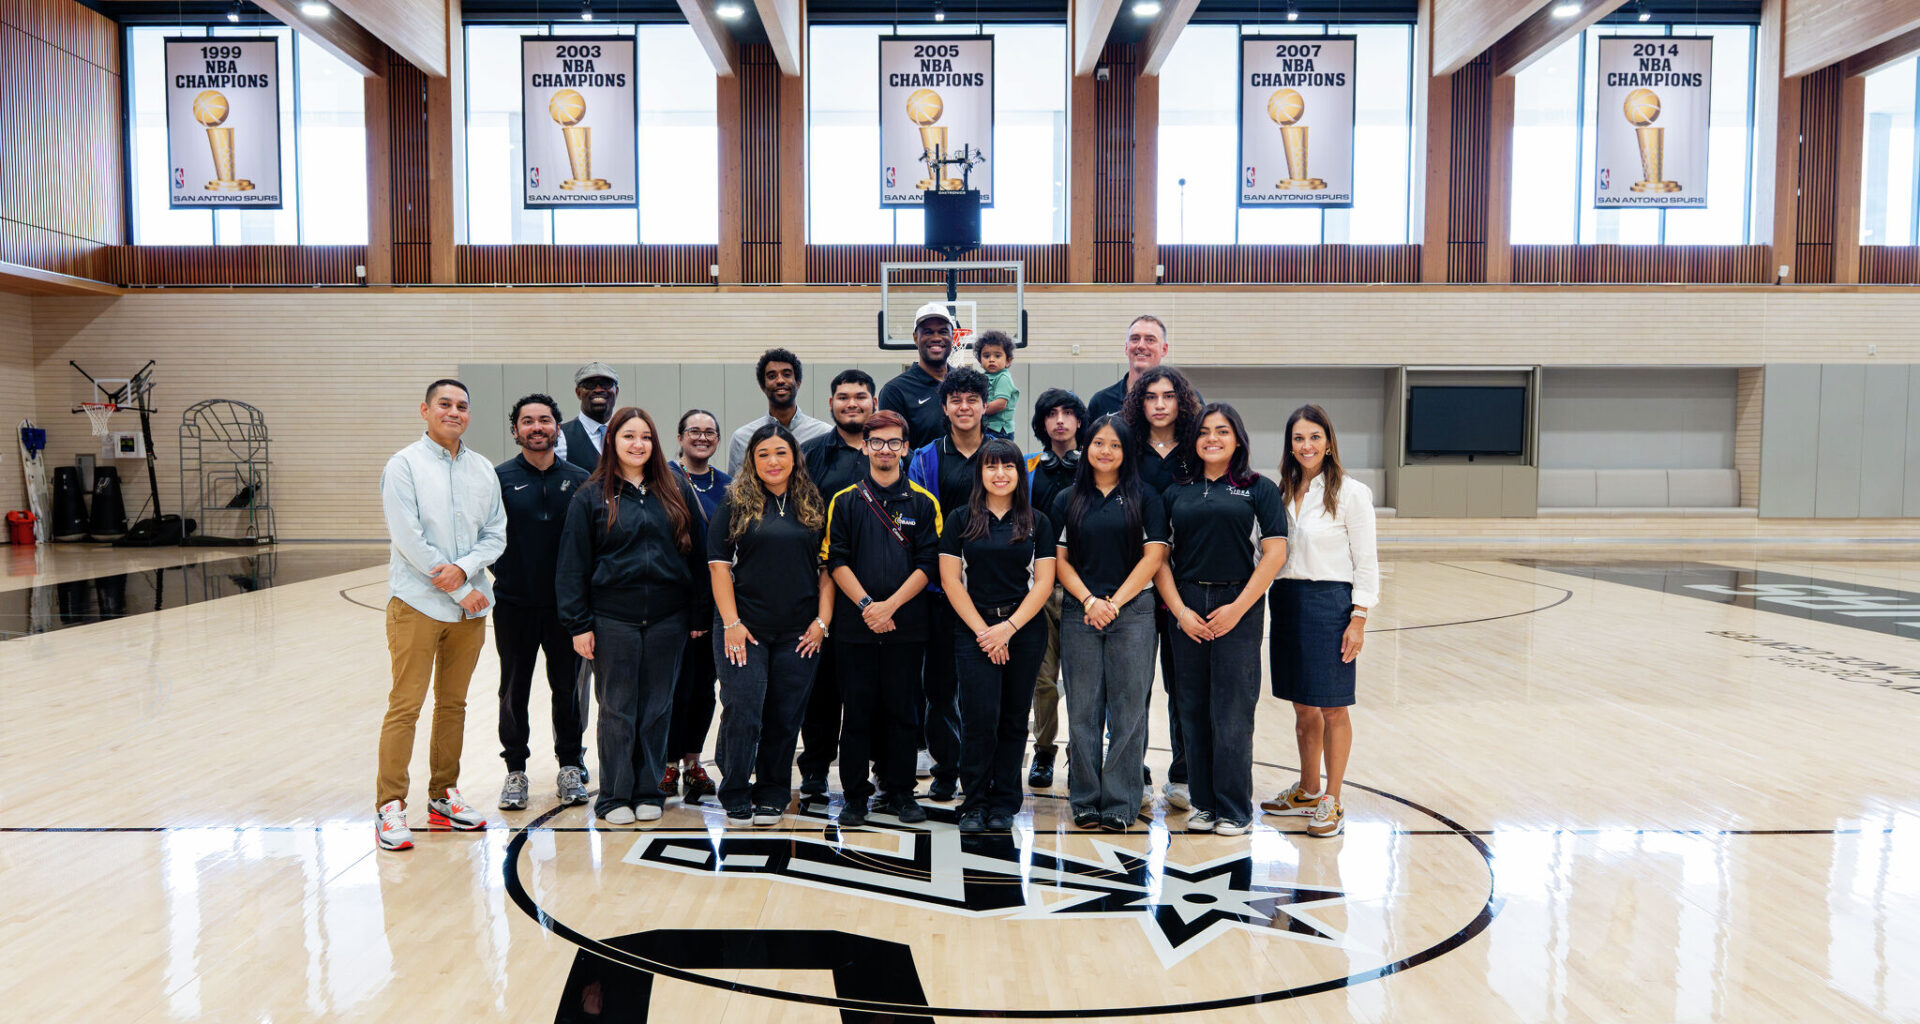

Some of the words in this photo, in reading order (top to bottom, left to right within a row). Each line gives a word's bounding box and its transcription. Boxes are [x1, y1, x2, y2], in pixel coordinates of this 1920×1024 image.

[201, 46, 242, 59] 1999
[556, 45, 602, 58] 2003
[914, 45, 960, 58] 2005
[1276, 44, 1322, 57] 2007
[1633, 43, 1679, 56] 2014
[205, 60, 238, 74] NBA
[562, 59, 595, 72] NBA
[920, 58, 953, 72] NBA
[1282, 58, 1315, 72] NBA
[1639, 57, 1672, 71] NBA
[175, 74, 269, 88] CHAMPIONS
[532, 73, 626, 87] CHAMPIONS
[889, 73, 984, 87] CHAMPIONS
[1251, 72, 1346, 87] CHAMPIONS
[1607, 72, 1703, 87] CHAMPIONS
